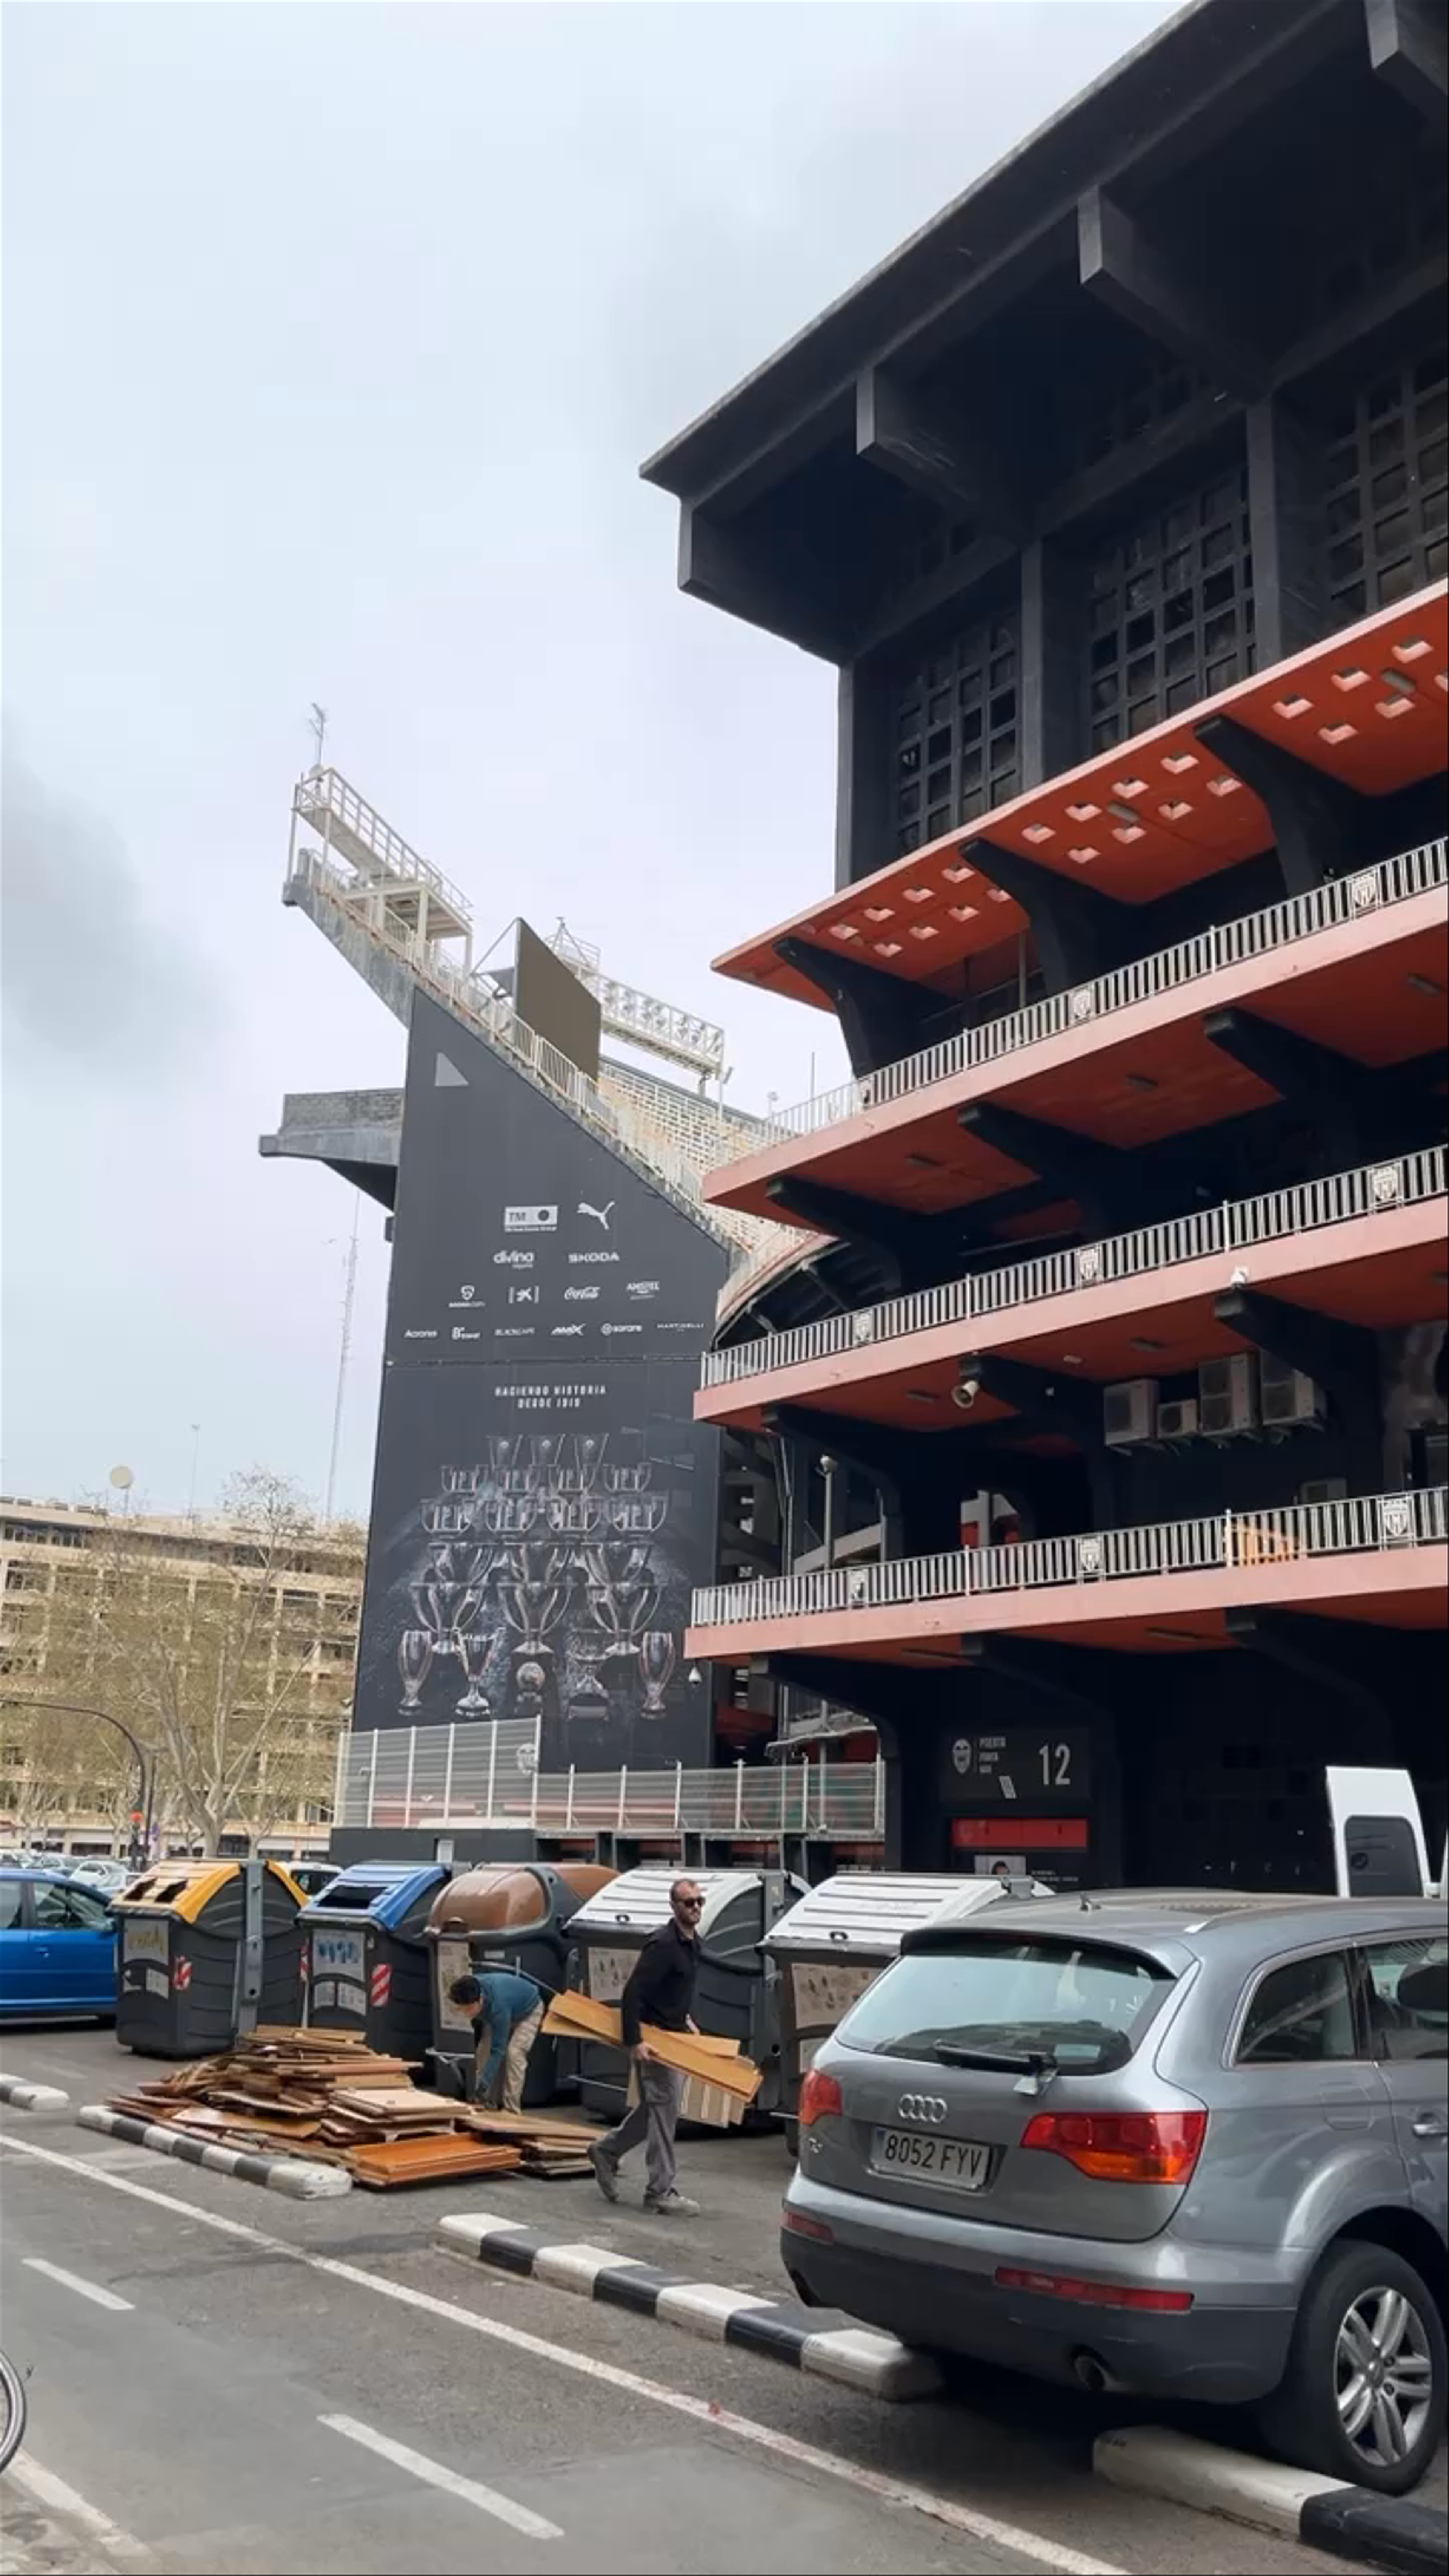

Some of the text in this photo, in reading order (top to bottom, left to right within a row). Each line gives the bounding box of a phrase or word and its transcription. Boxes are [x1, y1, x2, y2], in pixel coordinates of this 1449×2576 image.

[495, 1385, 606, 1396] HACIENDO HISTORIA
[518, 1398, 551, 1409] DESDE
[1039, 1744, 1071, 1785] 12
[885, 2134, 981, 2177] 8052 FYV
